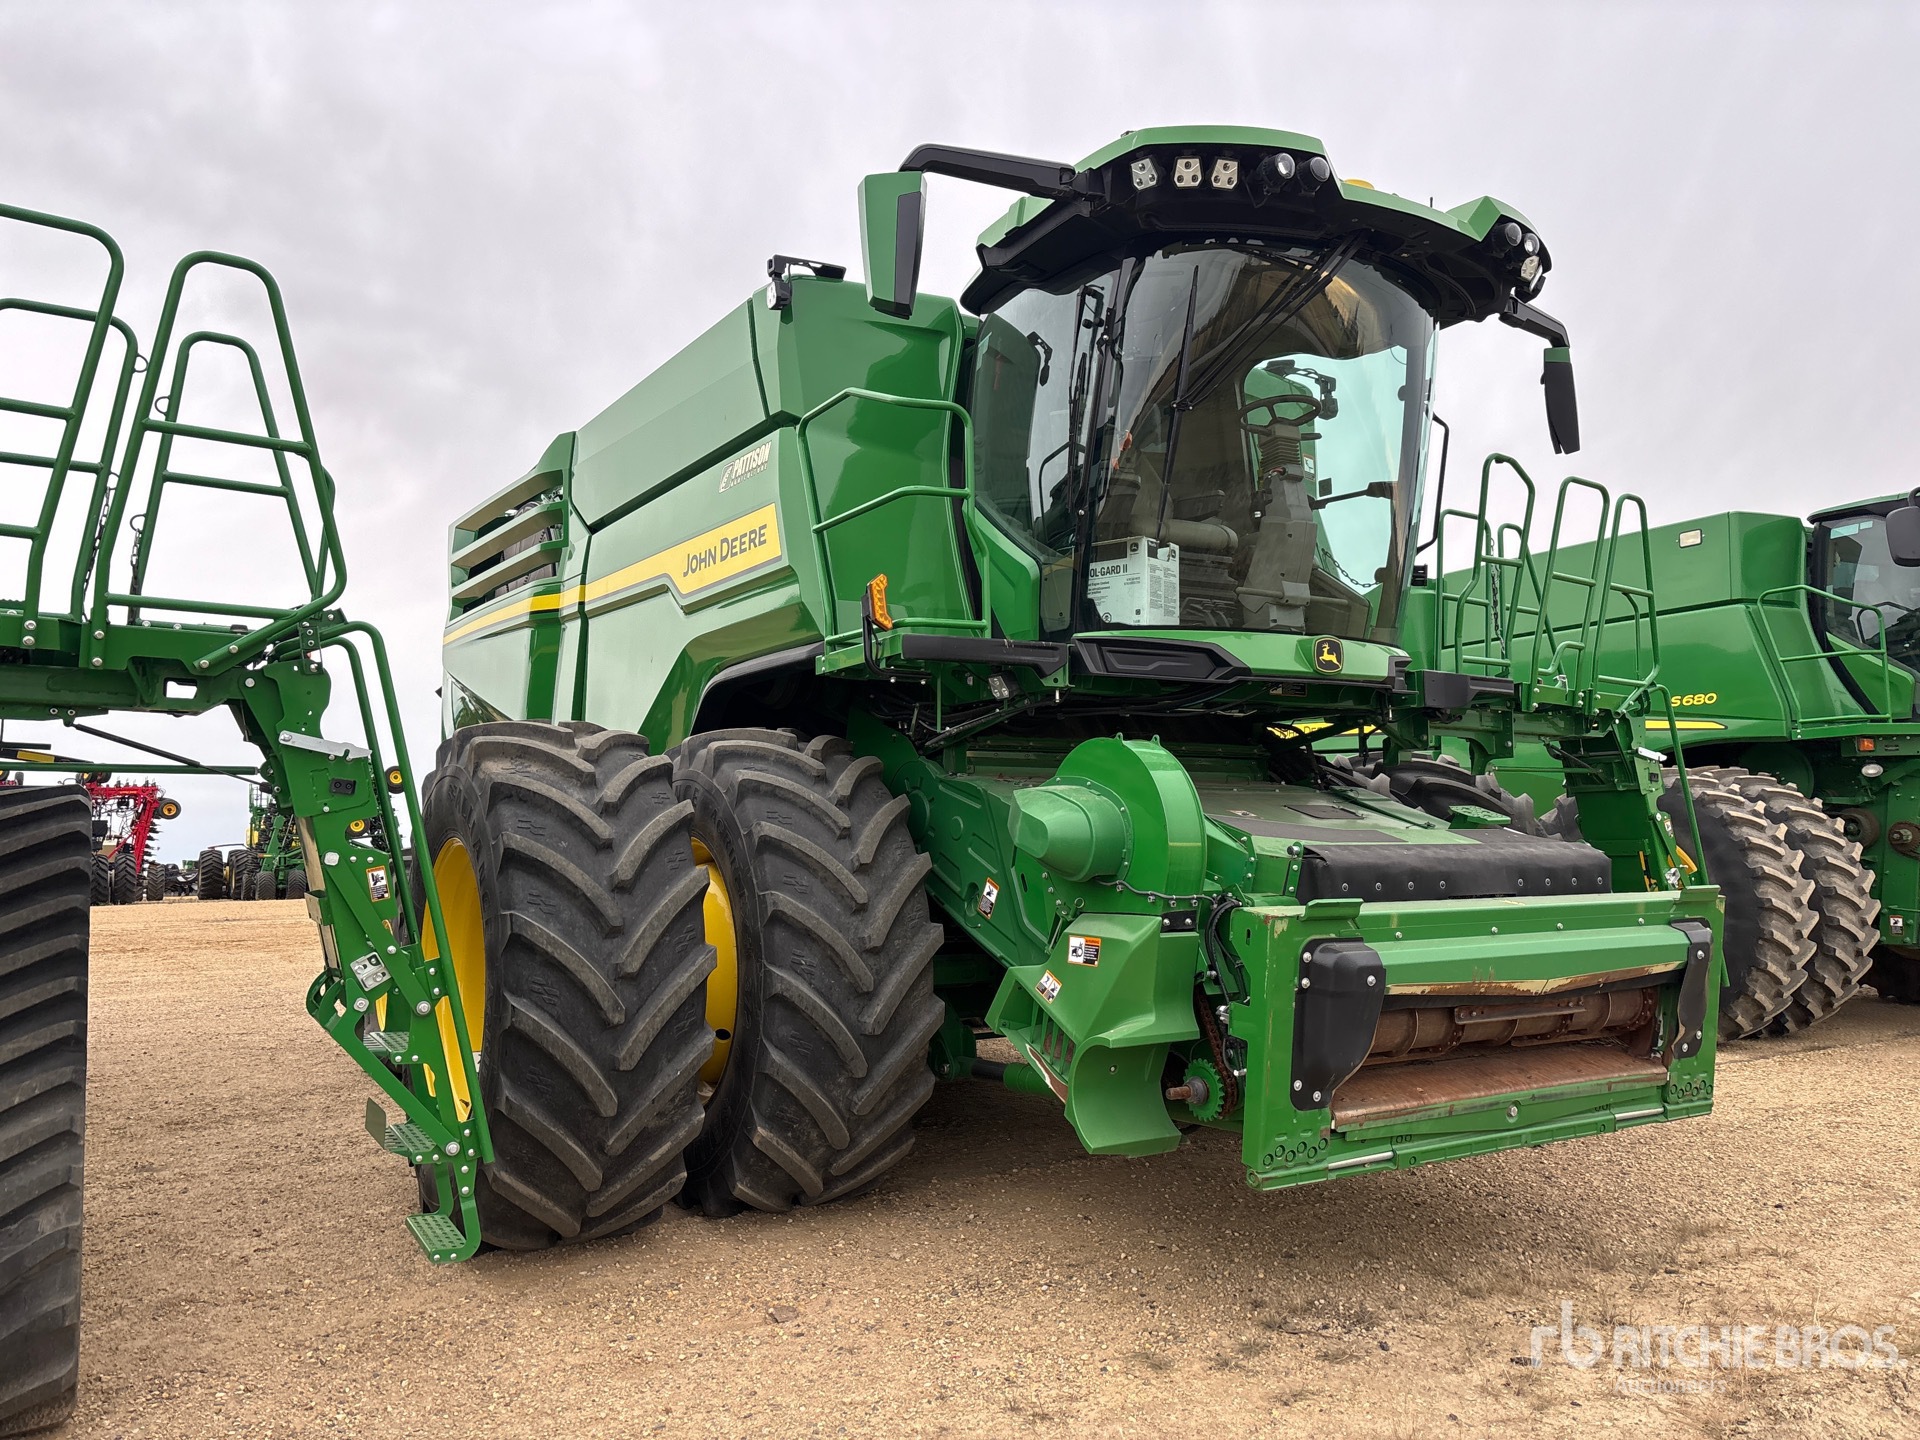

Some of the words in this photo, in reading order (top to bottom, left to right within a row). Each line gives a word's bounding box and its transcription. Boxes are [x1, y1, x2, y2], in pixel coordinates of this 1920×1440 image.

[732, 440, 771, 480] PATTISON
[682, 545, 717, 577] JOHN
[719, 523, 767, 562] DEERE
[1089, 564, 1121, 578] OL-GARD
[1670, 692, 1717, 707] S680
